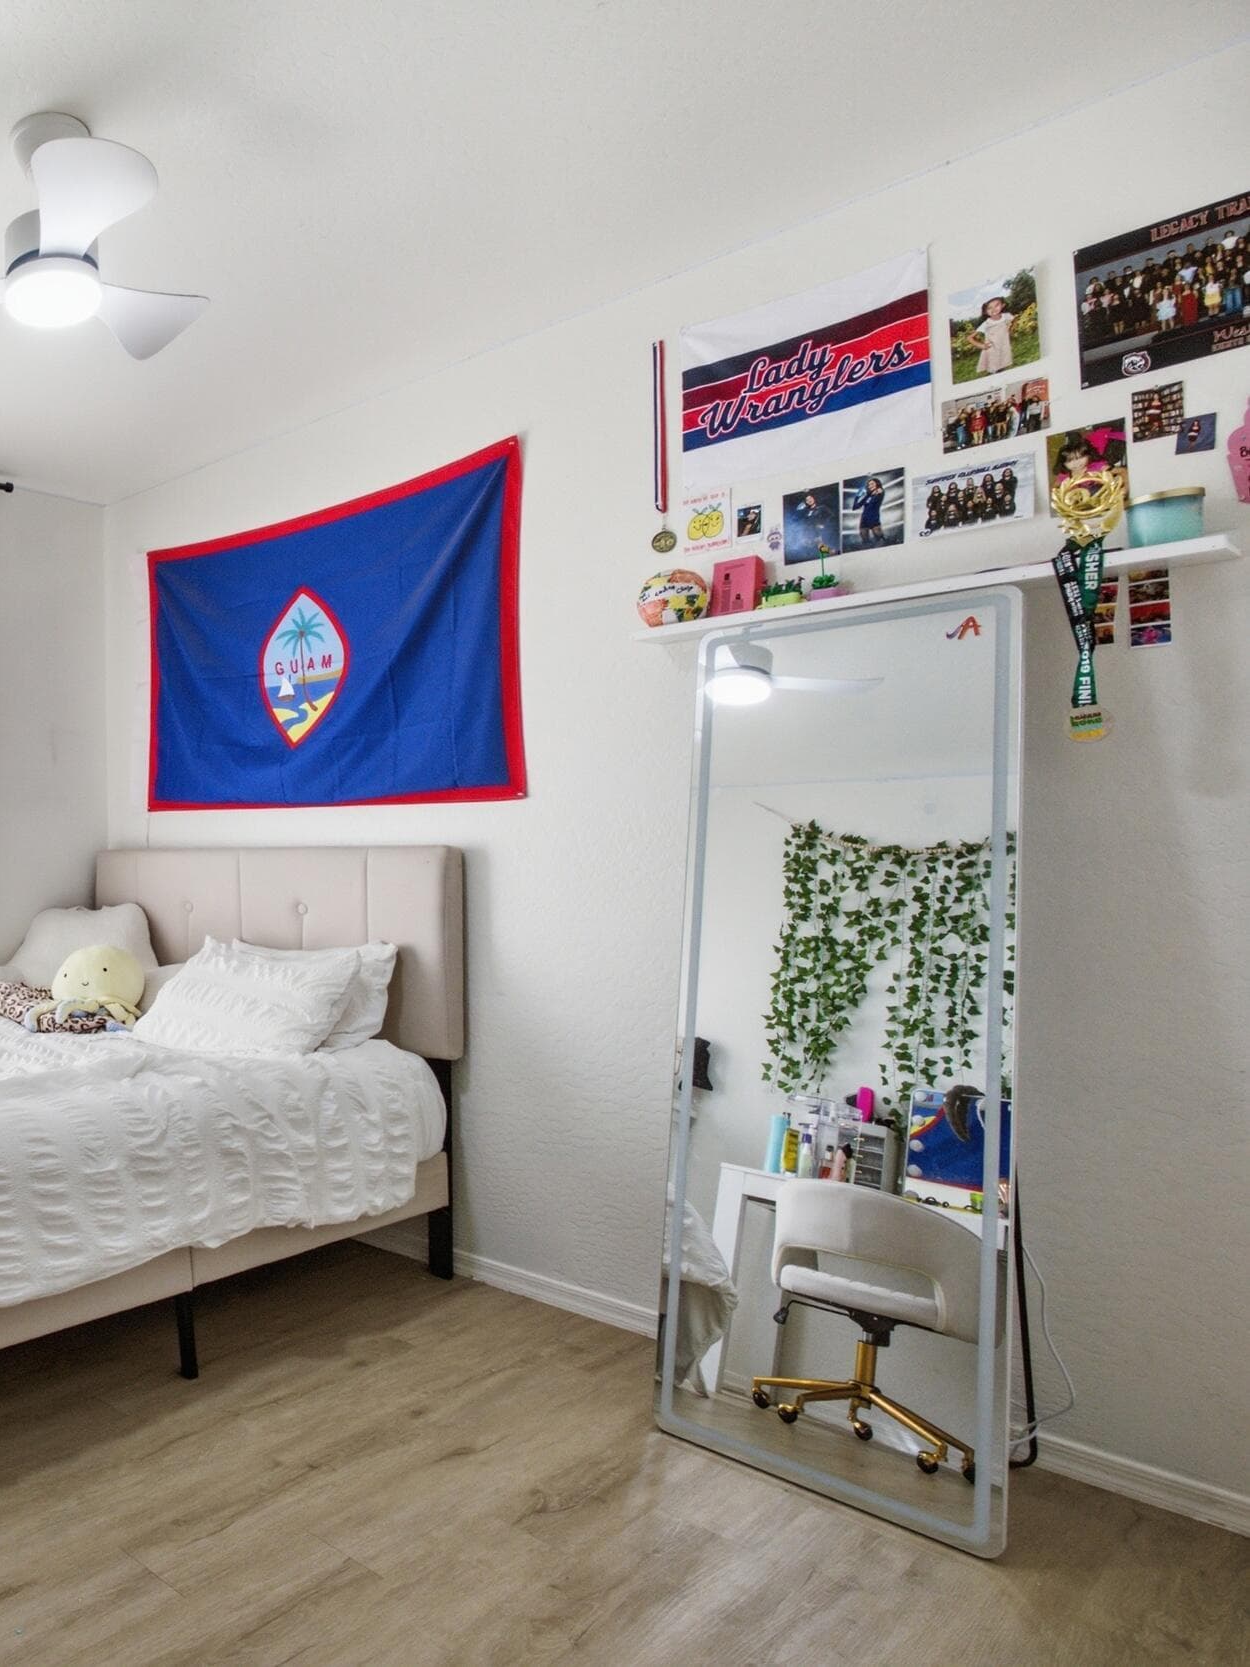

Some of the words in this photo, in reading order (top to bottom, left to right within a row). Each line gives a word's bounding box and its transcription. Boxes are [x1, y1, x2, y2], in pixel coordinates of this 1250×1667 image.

[1150, 209, 1210, 242] LEGACY
[742, 339, 835, 394] Lady
[699, 340, 914, 439] Wranglers
[275, 654, 332, 676] GUAM
